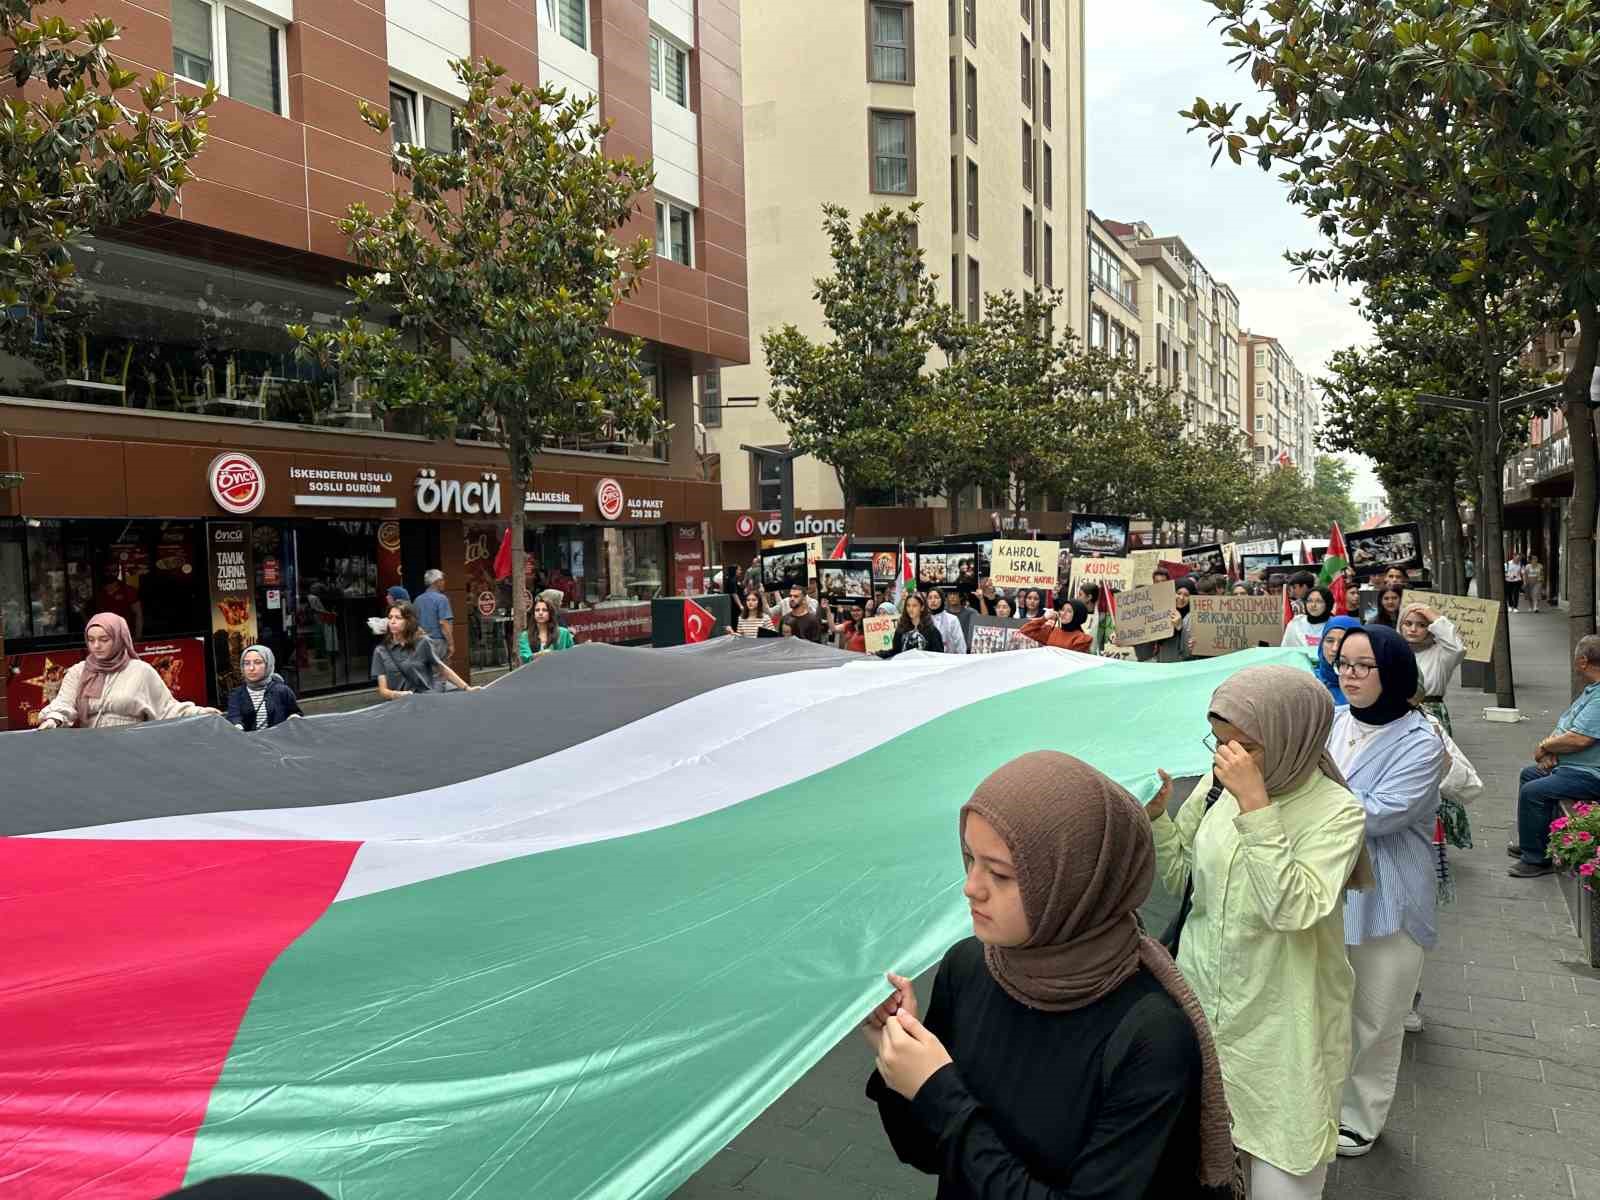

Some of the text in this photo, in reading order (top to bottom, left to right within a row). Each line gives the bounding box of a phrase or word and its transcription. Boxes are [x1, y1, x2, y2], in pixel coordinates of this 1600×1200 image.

[309, 482, 343, 492] SOSLU
[627, 499, 641, 508] ALO
[758, 515, 845, 535] voafone
[998, 545, 1040, 558] KAHROL
[216, 552, 245, 565] TAVUK
[217, 566, 246, 578] ZURNA
[1194, 599, 1213, 611] HER
